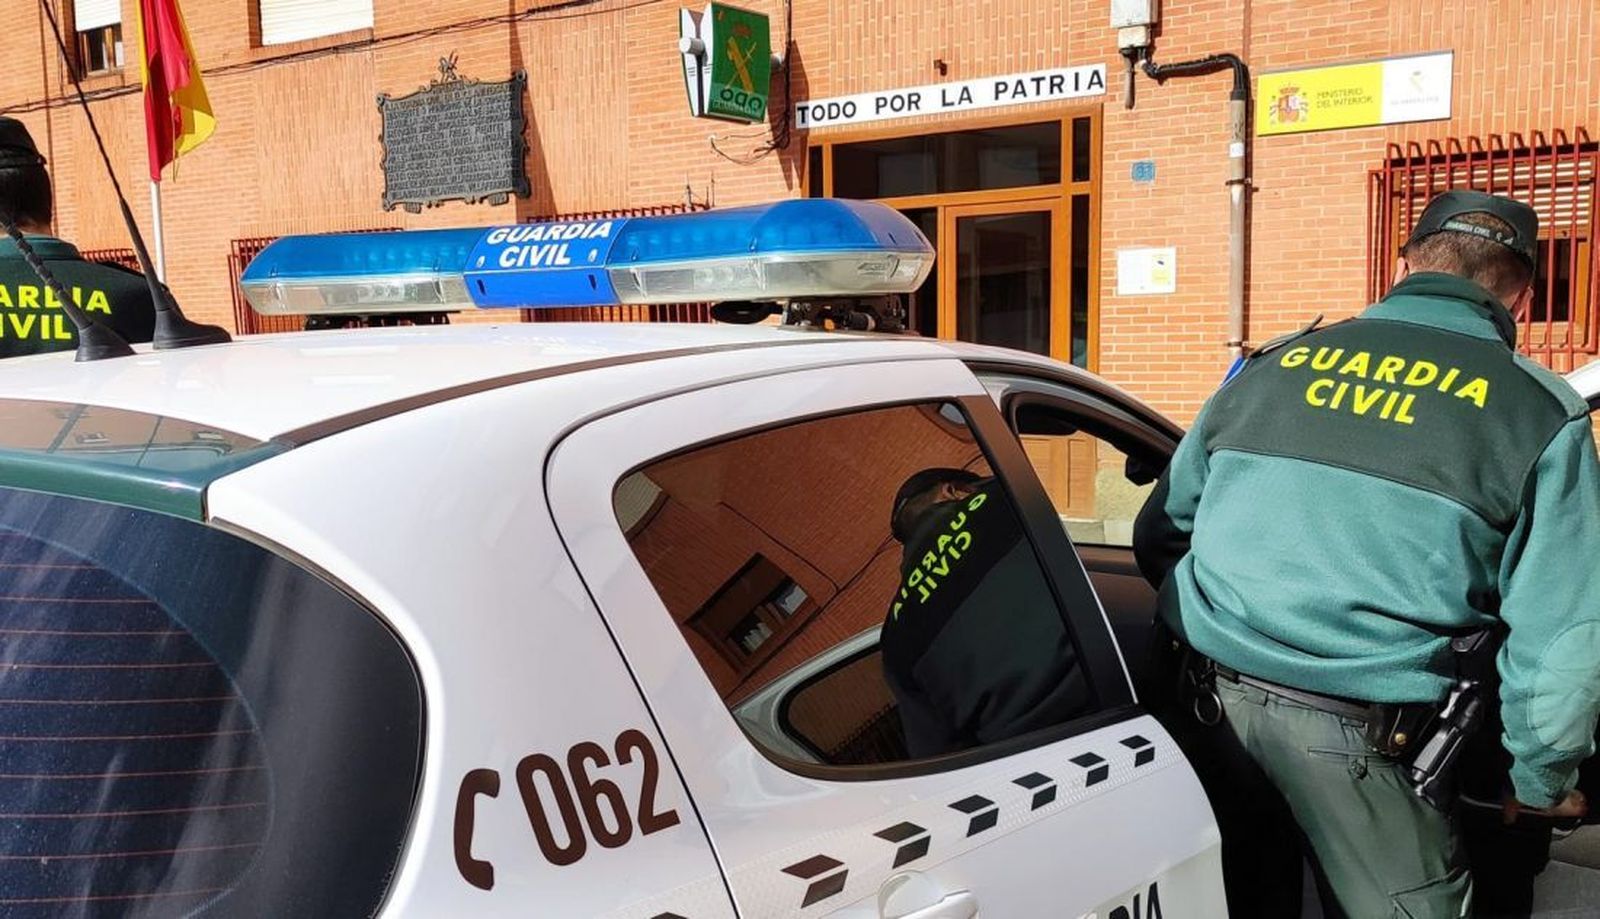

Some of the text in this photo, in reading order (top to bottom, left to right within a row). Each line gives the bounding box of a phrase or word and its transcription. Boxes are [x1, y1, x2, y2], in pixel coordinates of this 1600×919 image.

[797, 69, 1104, 124] TODO POR LA PATRIA
[486, 221, 613, 245] GUARDIA
[499, 243, 571, 268] CIVIL
[1280, 346, 1489, 409] GUARDIA
[1305, 378, 1417, 425] CIVIL
[515, 728, 681, 866] 062
